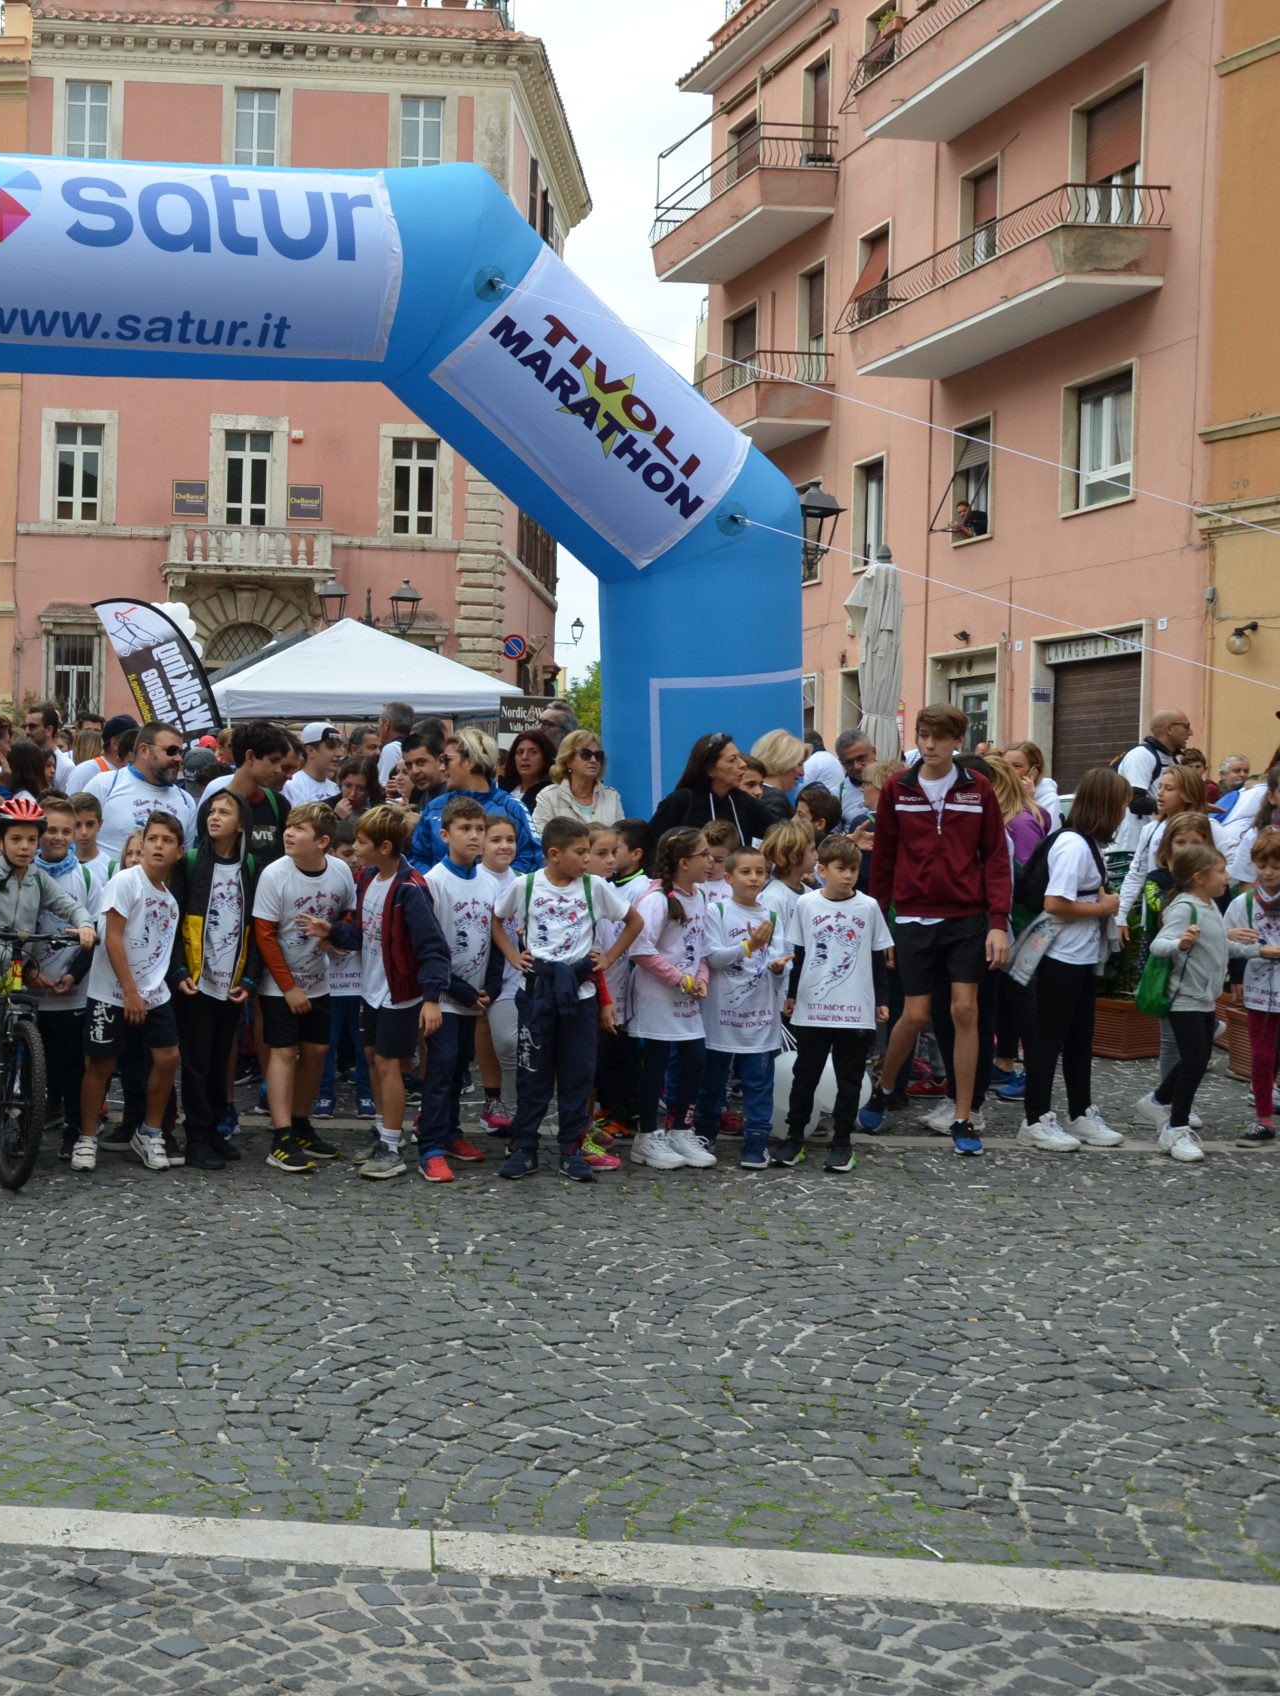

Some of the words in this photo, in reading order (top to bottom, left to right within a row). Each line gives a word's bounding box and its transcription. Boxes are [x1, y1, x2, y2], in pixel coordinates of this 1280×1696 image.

[60, 174, 373, 261] satur
[489, 315, 705, 520] MARATHON
[543, 314, 701, 480] TIVOLI
[1047, 640, 1098, 661] LAVAGGIO
[1103, 638, 1109, 654] A
[501, 705, 527, 719] Nordic
